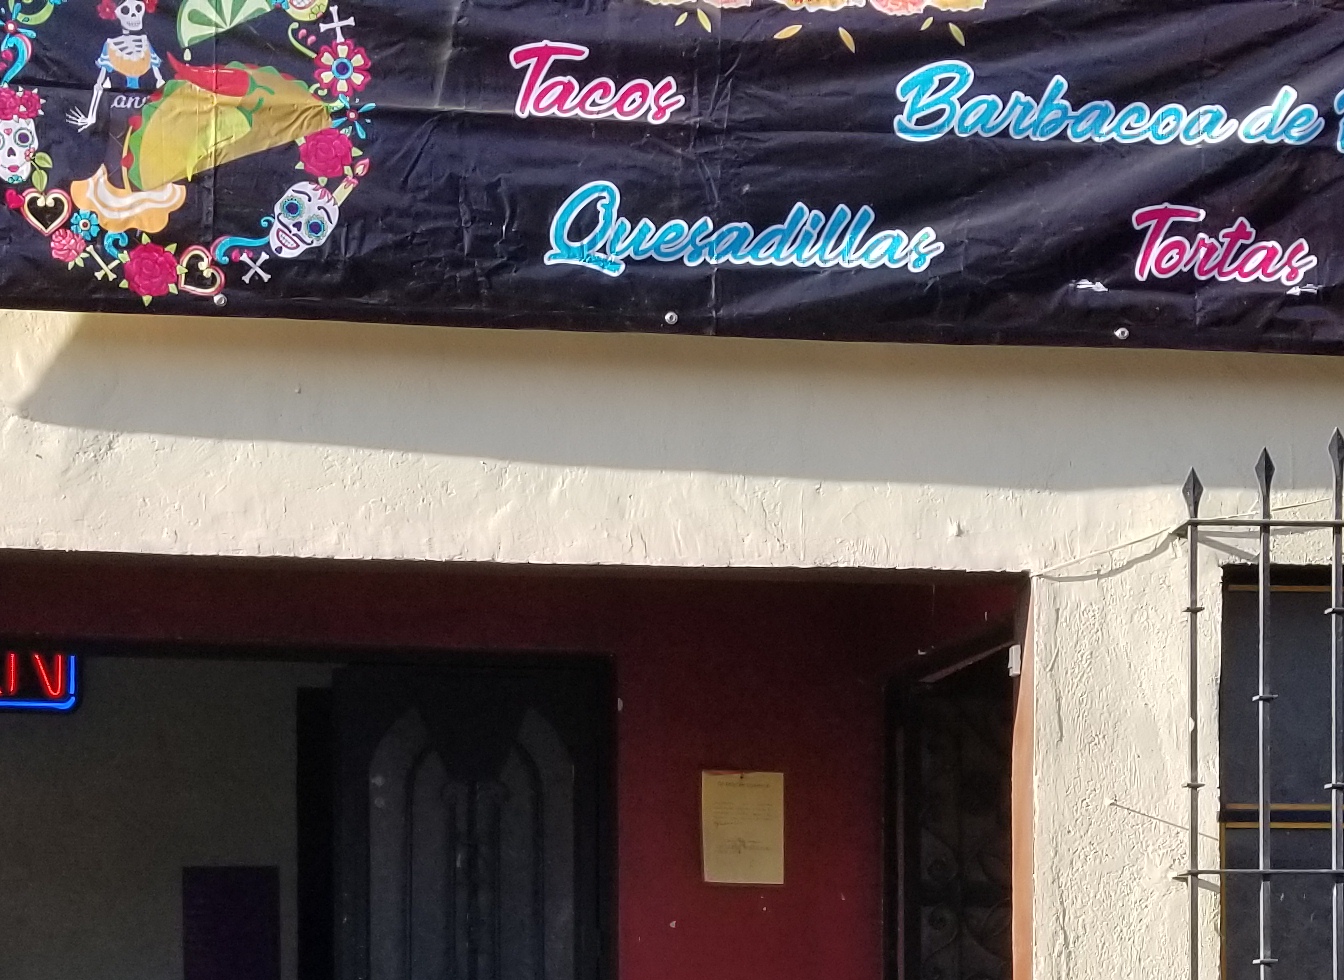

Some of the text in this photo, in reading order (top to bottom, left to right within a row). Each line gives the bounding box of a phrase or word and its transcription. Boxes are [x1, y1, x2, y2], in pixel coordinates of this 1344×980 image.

[509, 40, 686, 124] Tacos
[894, 60, 1238, 146] Barbacoa
[1239, 85, 1326, 147] de
[544, 180, 944, 277] Quesadillas
[1131, 203, 1320, 283] Tortas
